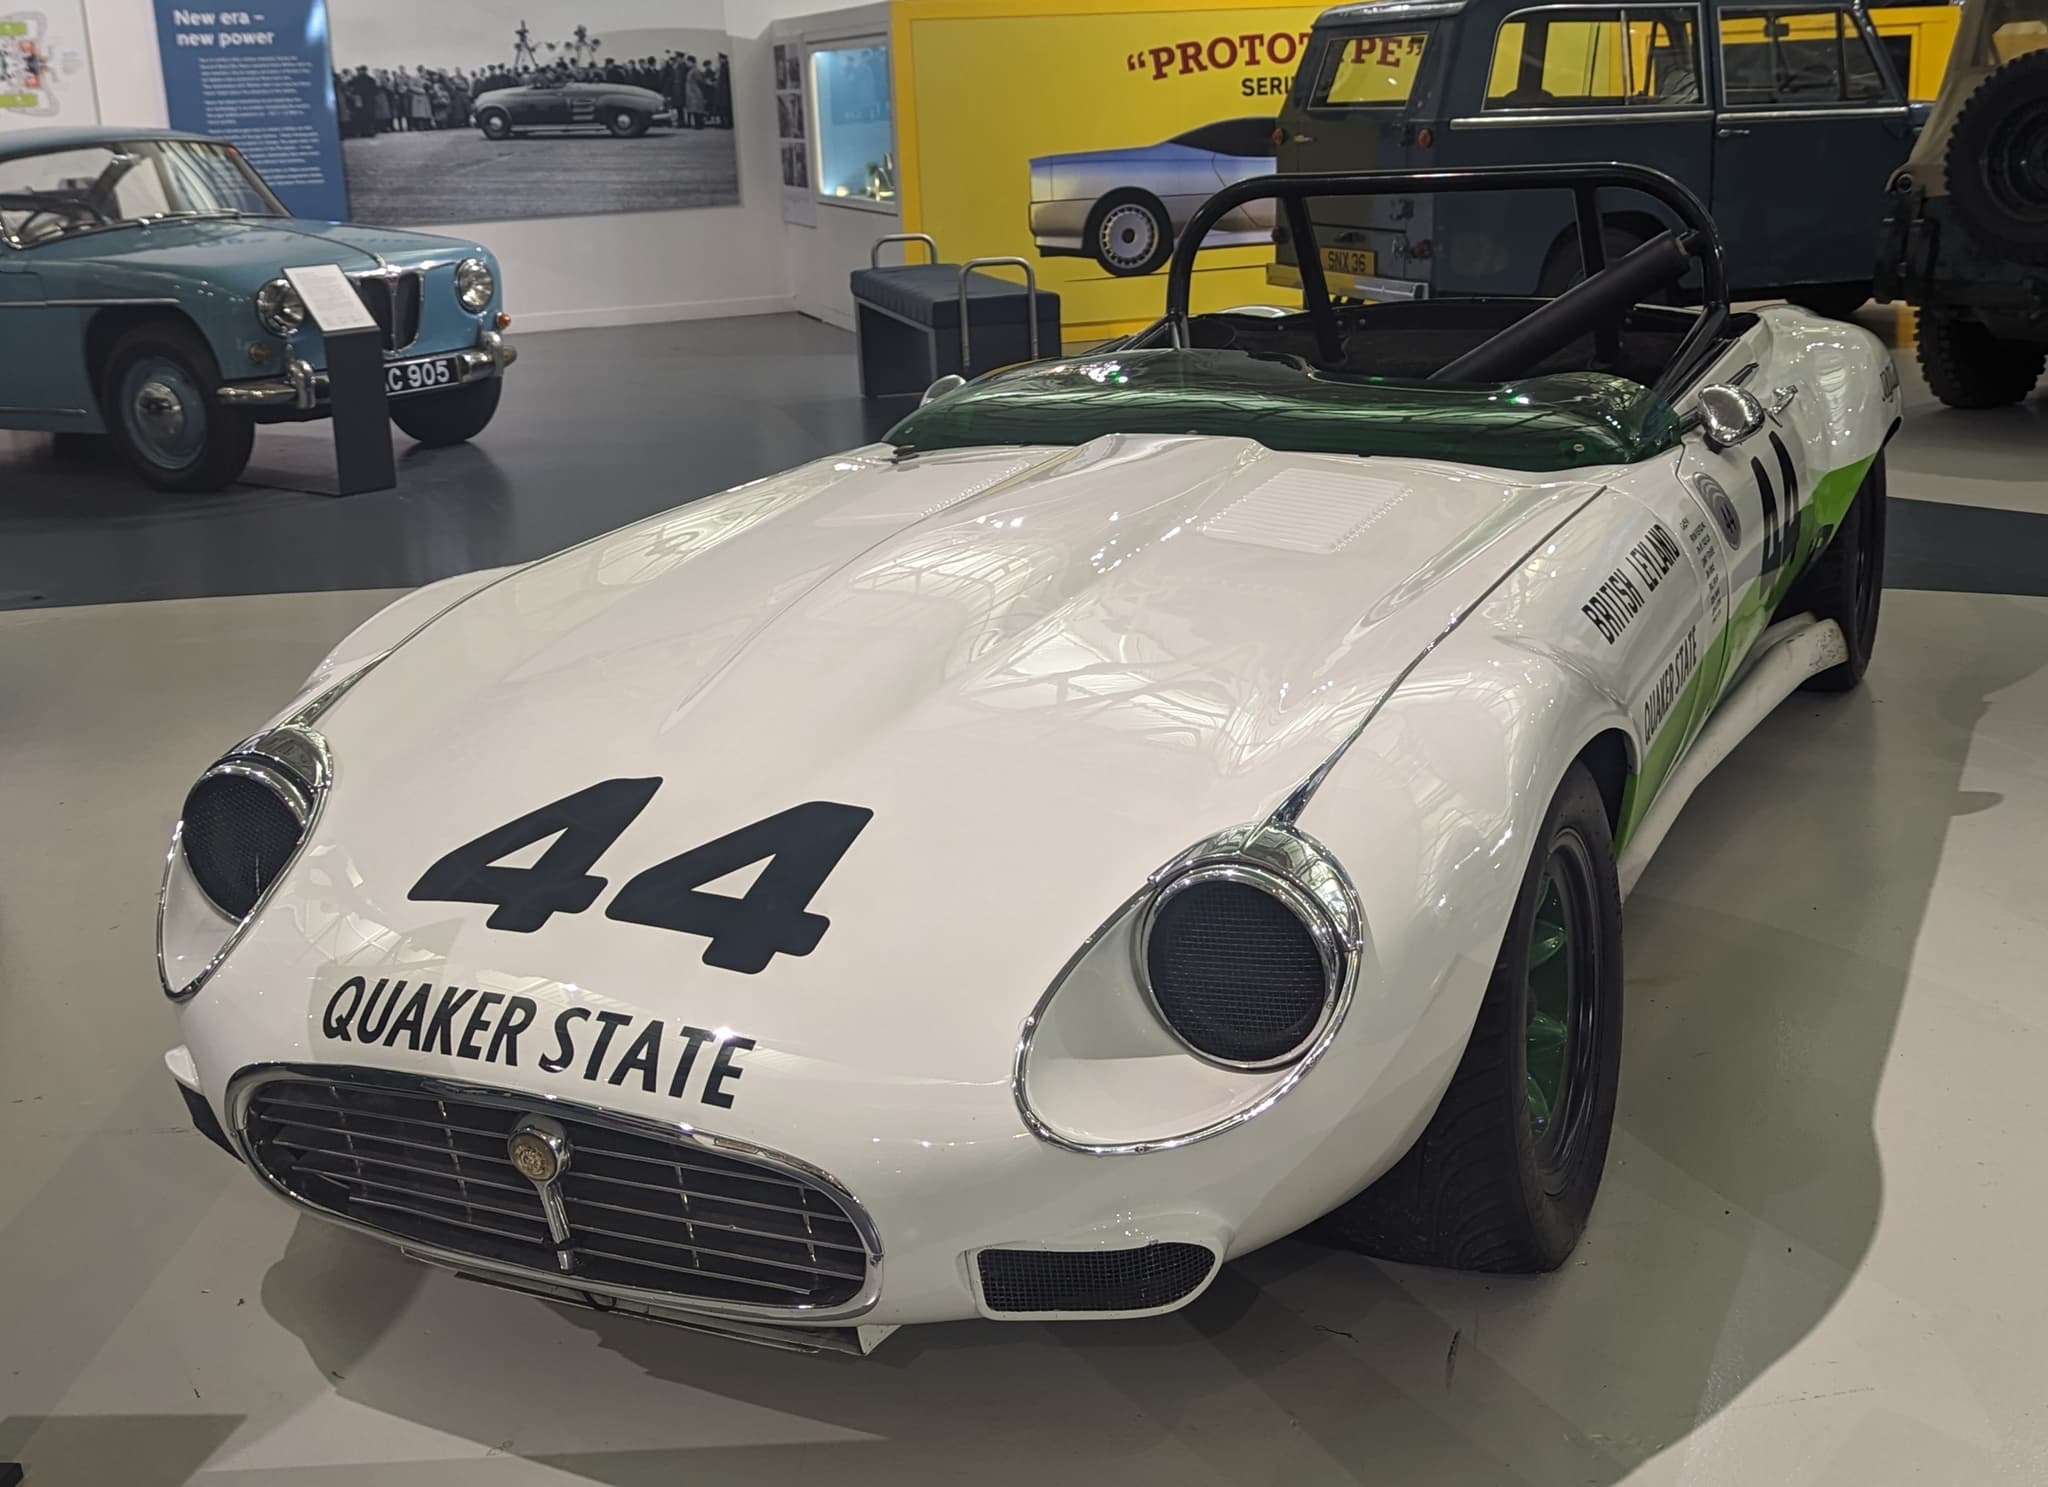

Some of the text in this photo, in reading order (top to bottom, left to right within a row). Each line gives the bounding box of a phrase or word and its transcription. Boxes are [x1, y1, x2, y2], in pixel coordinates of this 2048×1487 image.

[173, 9, 215, 26] New
[219, 11, 250, 26] era
[176, 31, 275, 48] new power
[1241, 76, 1294, 97] SERI
[1352, 253, 1366, 273] 36
[385, 360, 450, 392] C 905
[1751, 430, 1801, 600] 44
[1581, 523, 1681, 645] BRITISH LEYLAND
[1643, 624, 1698, 745] QUAKER STATE
[407, 776, 874, 974] 44
[321, 975, 757, 1109] QUAKER STATE
